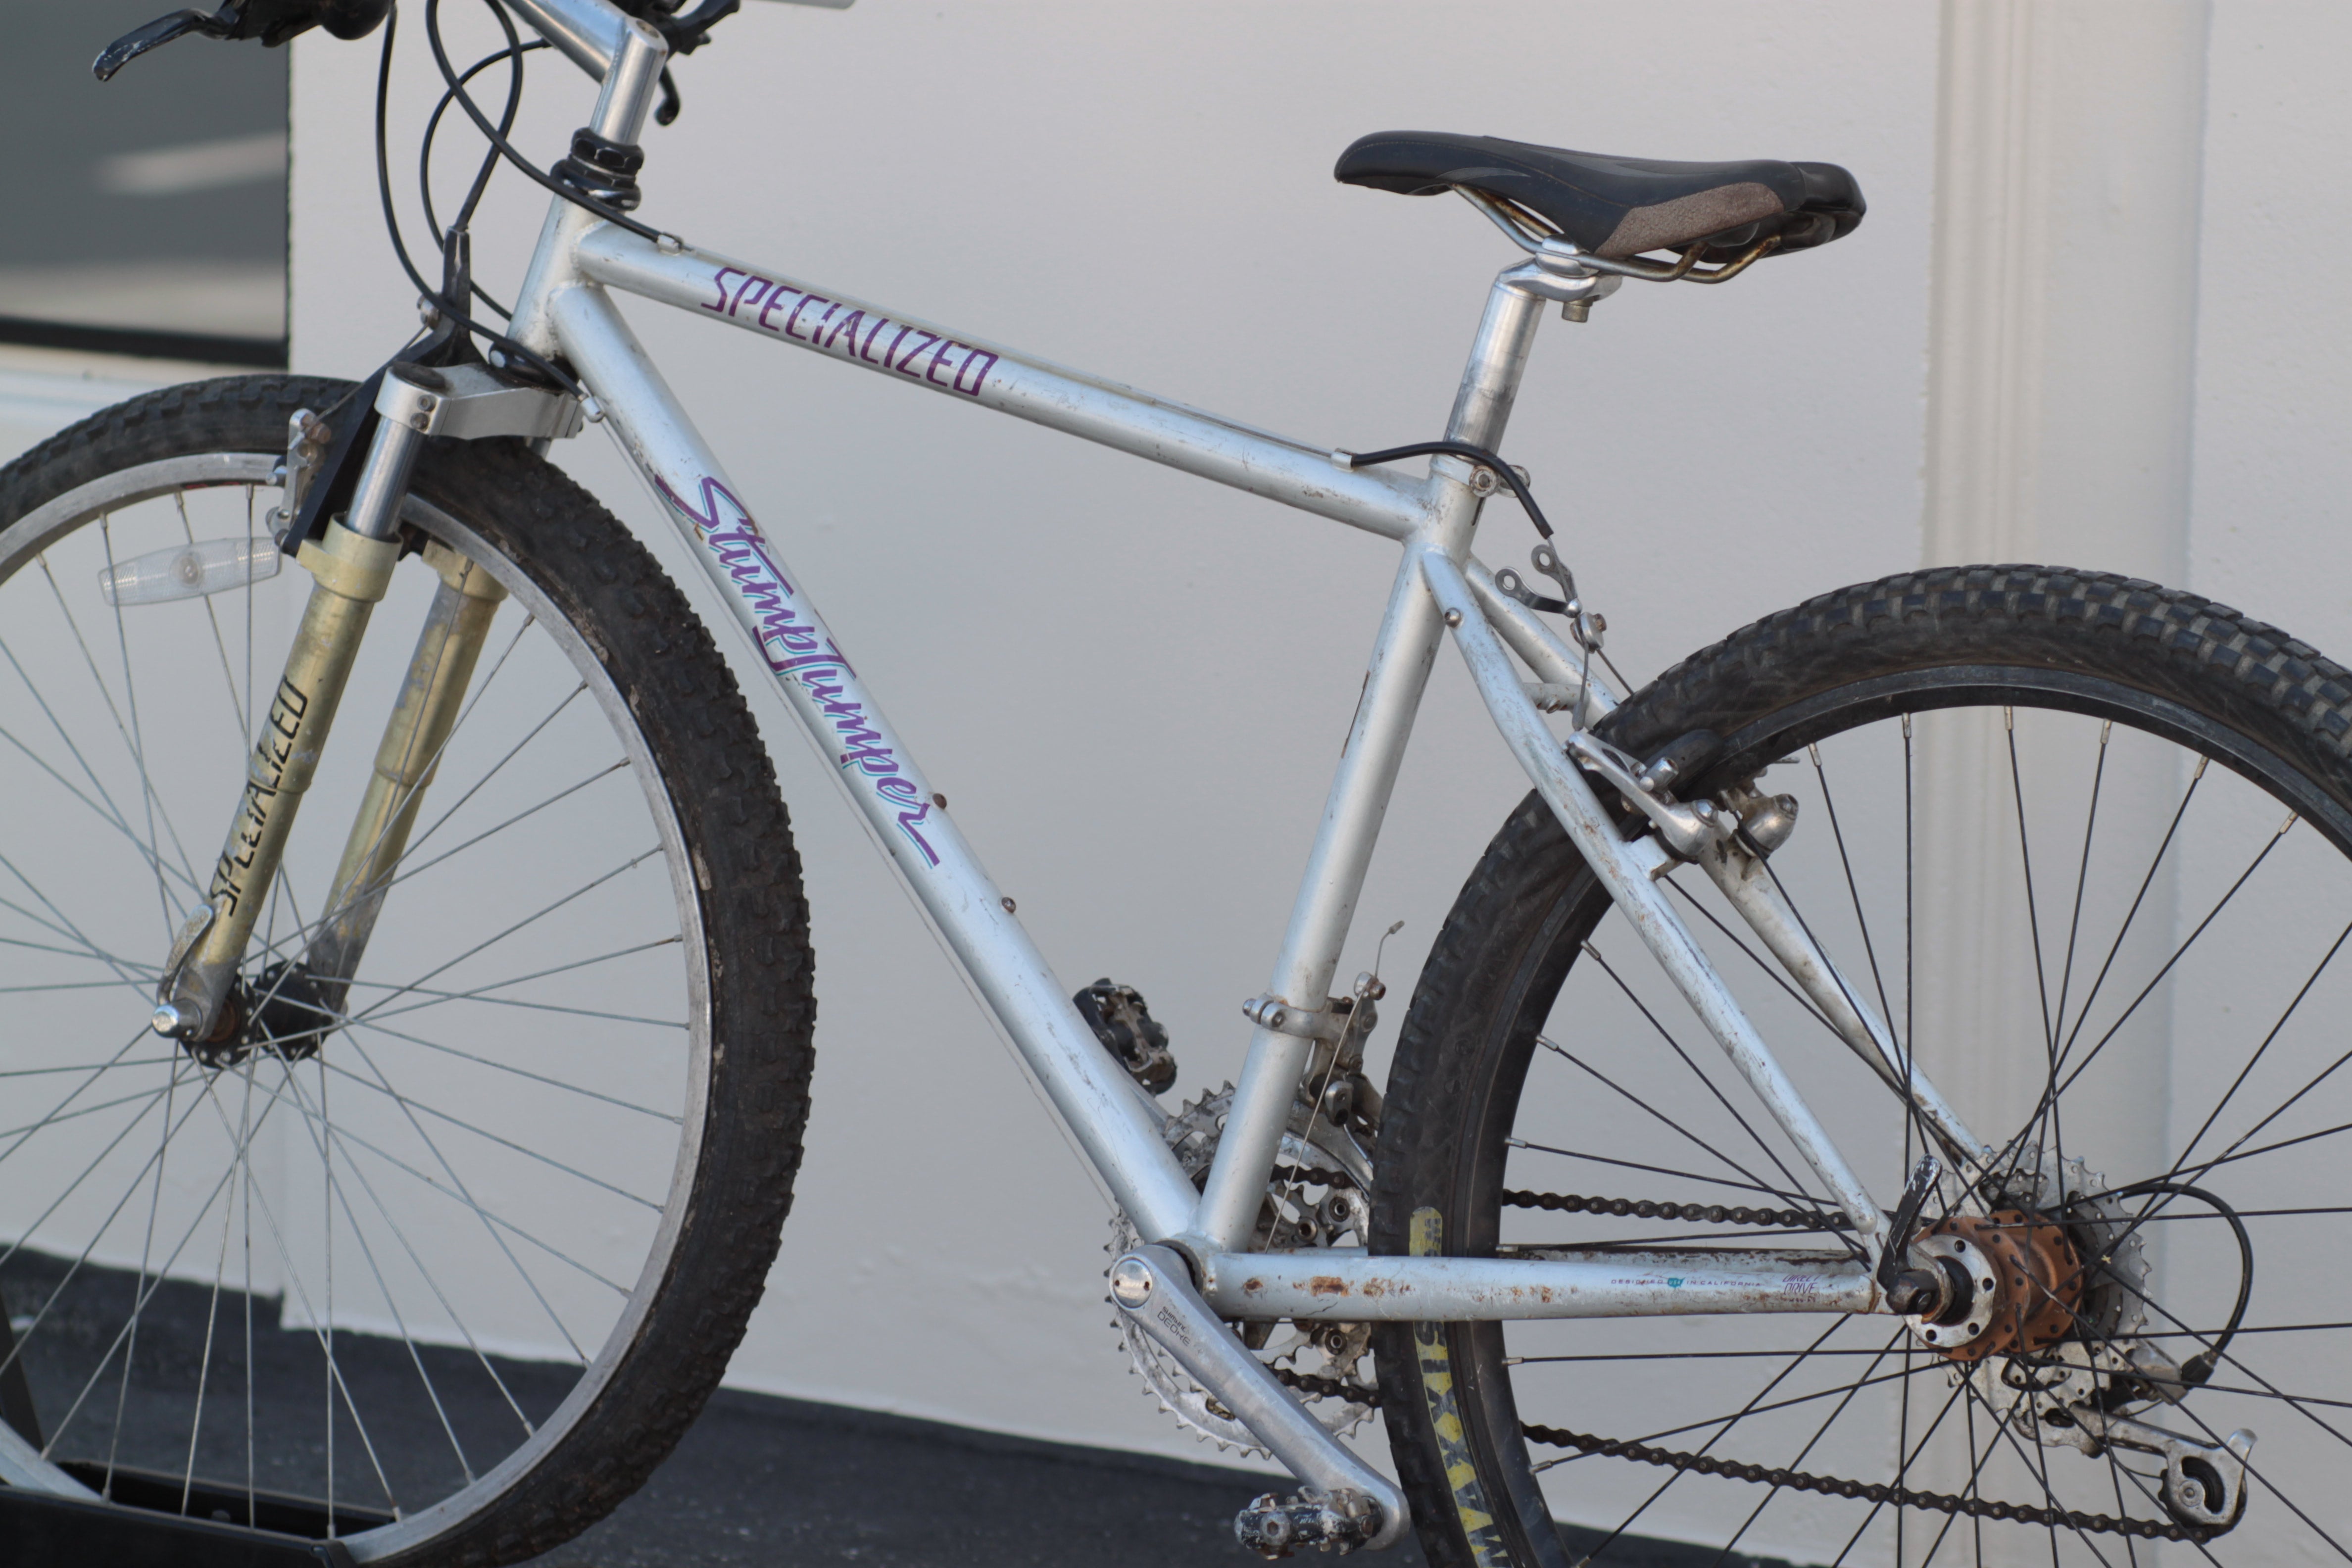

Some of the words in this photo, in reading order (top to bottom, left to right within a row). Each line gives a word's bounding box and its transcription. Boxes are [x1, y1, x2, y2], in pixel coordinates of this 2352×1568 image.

[700, 266, 999, 396] SPECIALIZED
[210, 674, 308, 917] SPECIALIZED
[1784, 1282, 1818, 1295] DRIVE
